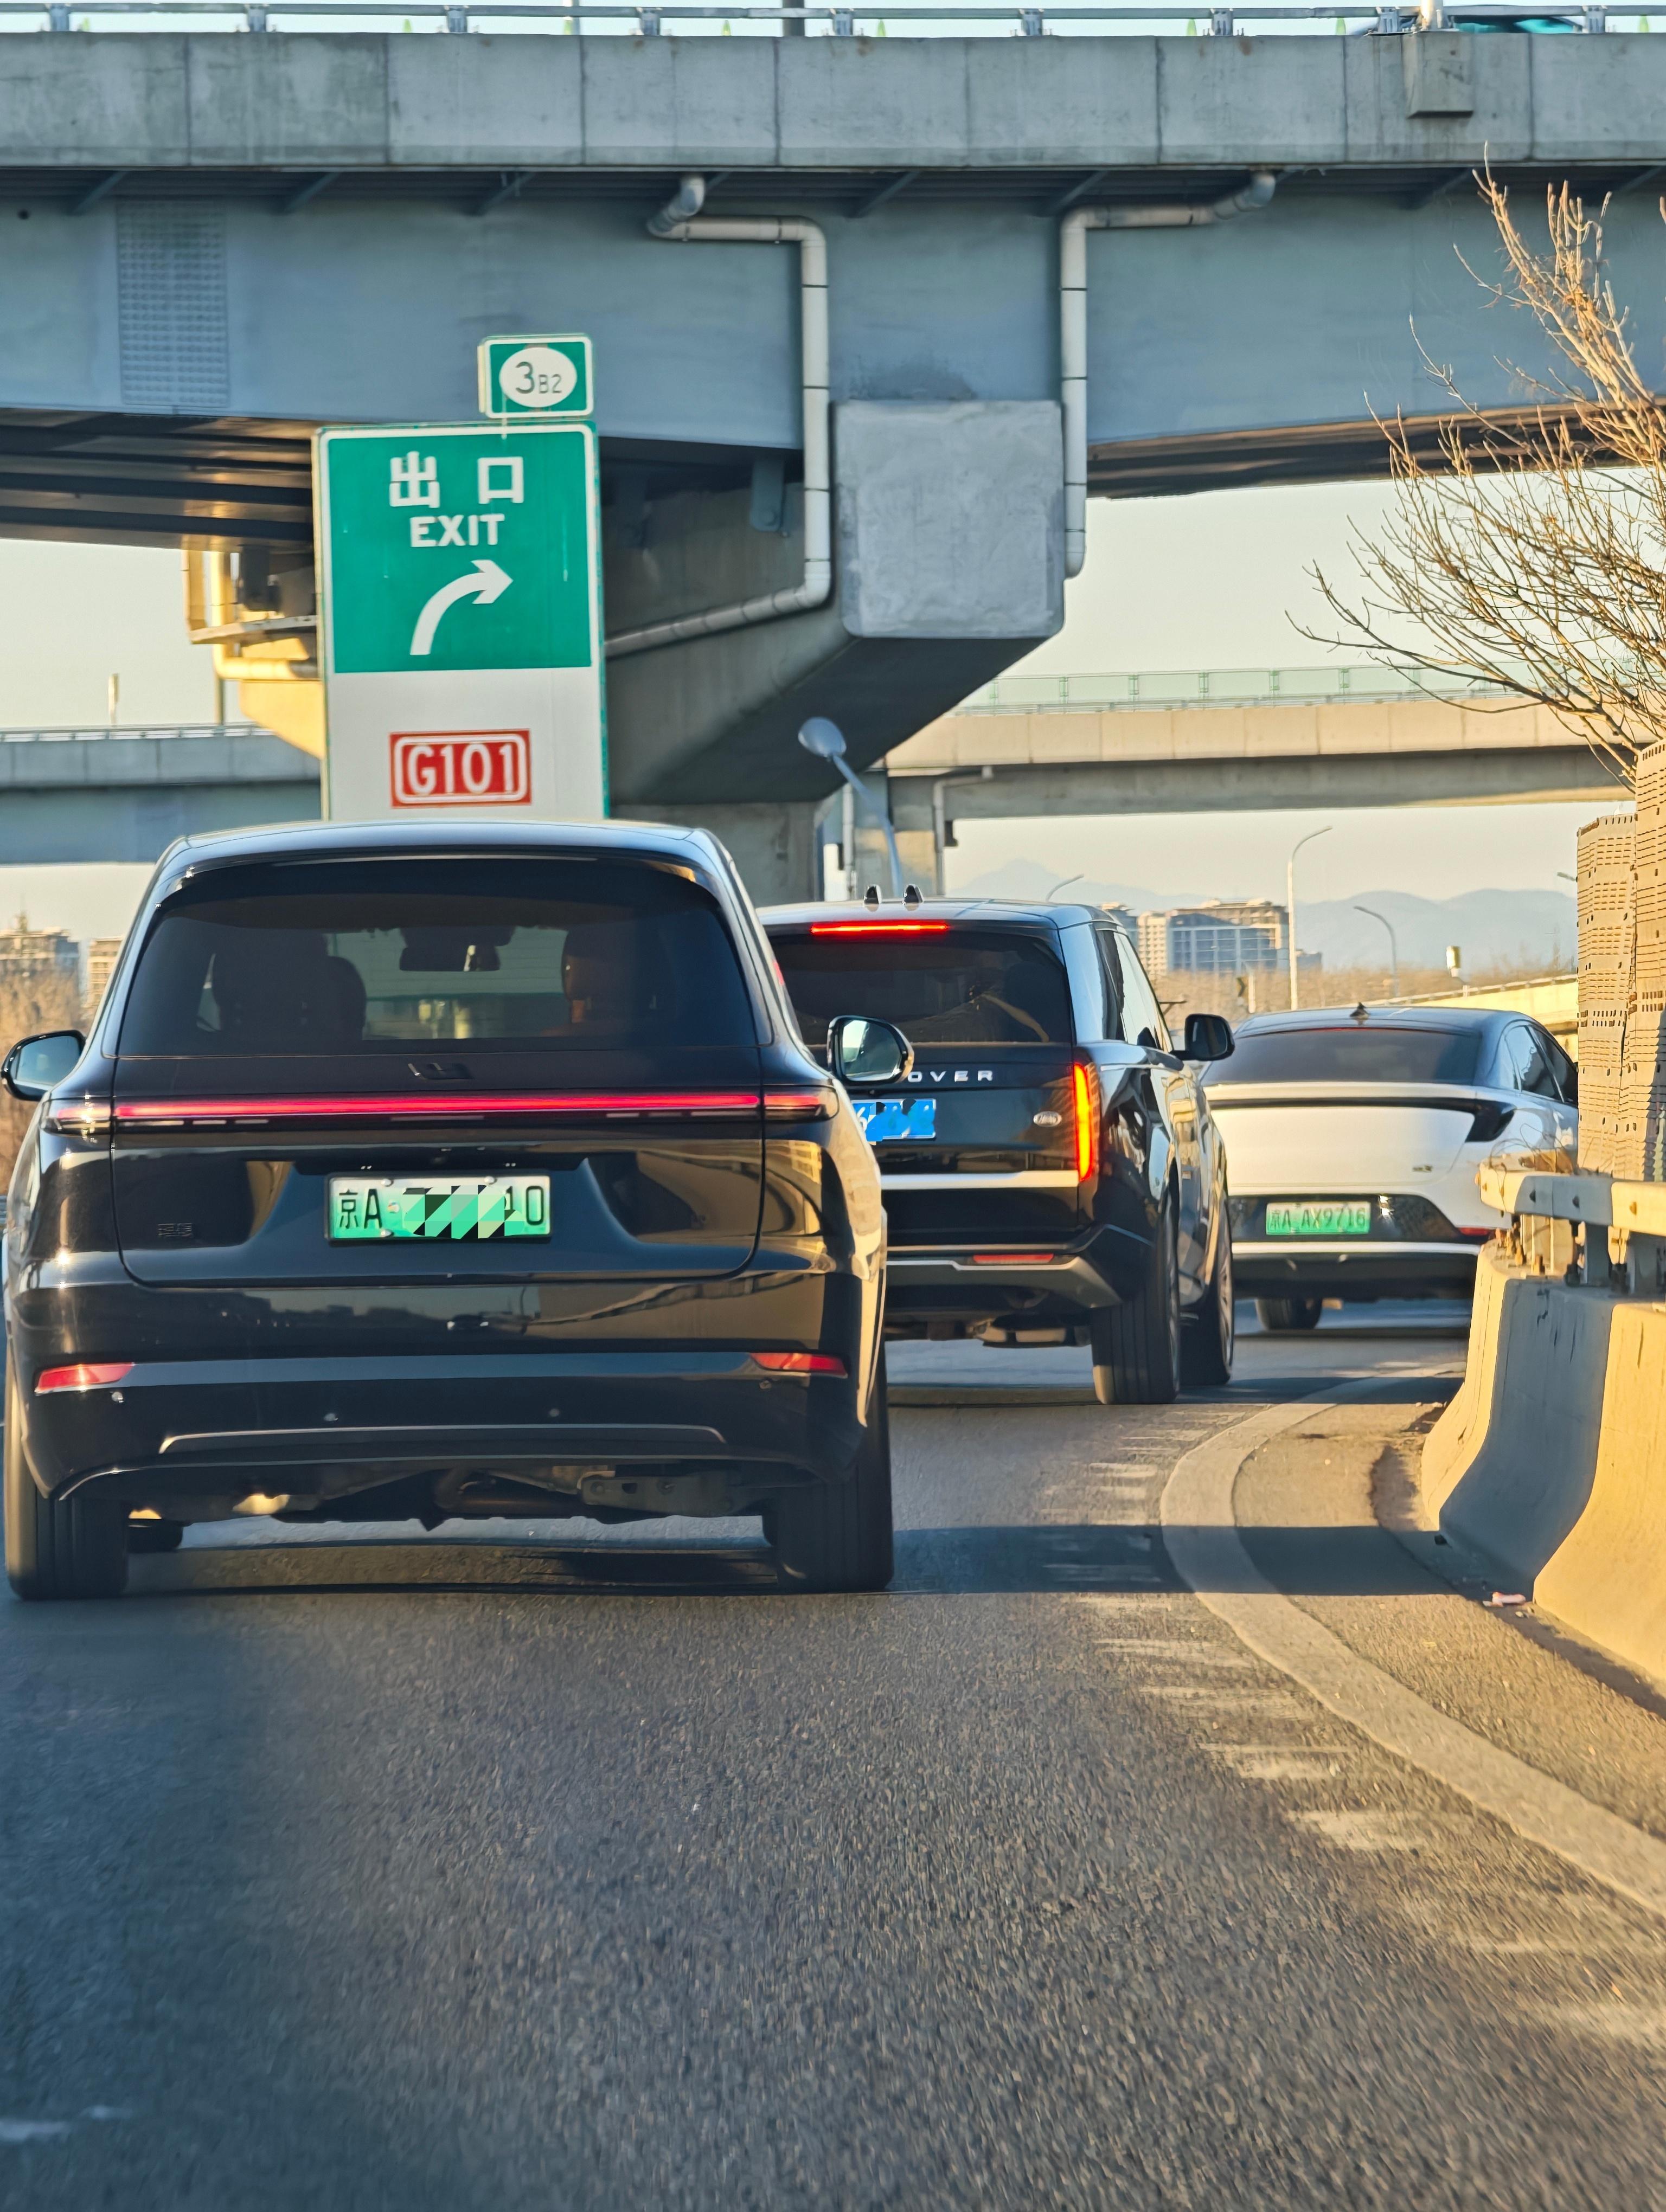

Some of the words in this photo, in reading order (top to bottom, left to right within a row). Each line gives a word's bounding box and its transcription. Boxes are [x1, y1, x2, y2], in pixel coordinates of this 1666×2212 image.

[389, 451, 524, 509] 出口
[409, 513, 505, 548] EXIT
[408, 744, 514, 794] G101
[907, 1070, 994, 1083] OVER
